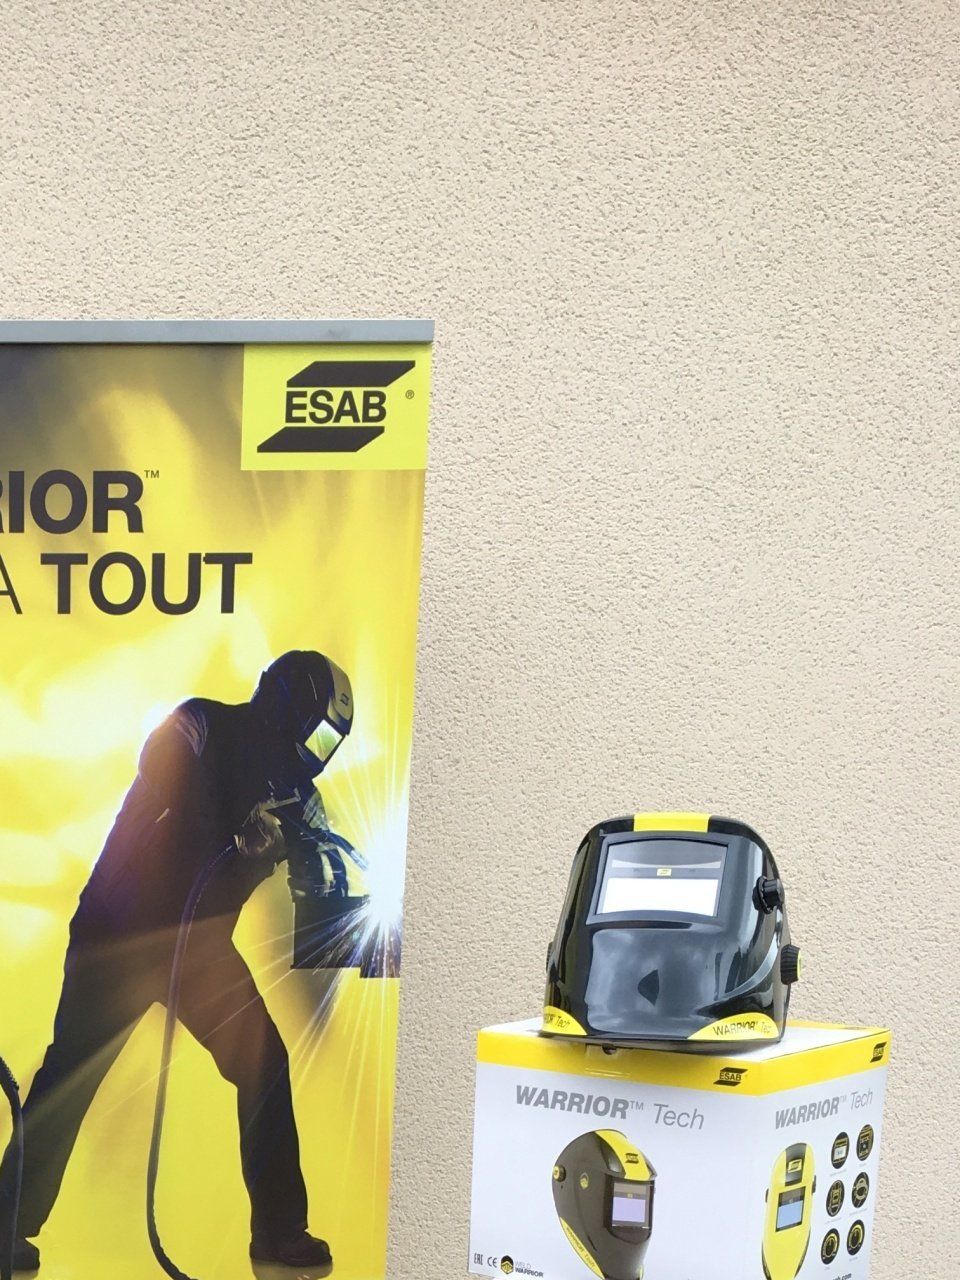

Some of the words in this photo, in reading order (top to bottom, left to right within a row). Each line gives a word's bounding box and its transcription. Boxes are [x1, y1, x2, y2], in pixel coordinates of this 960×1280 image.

[285, 389, 387, 424] ESAB
[40, 552, 253, 616] TOUT
[719, 1071, 742, 1082] ESAB
[850, 1087, 873, 1111] Tech
[653, 1102, 705, 1130] Tech
[515, 1267, 544, 1278] WARRIOR
